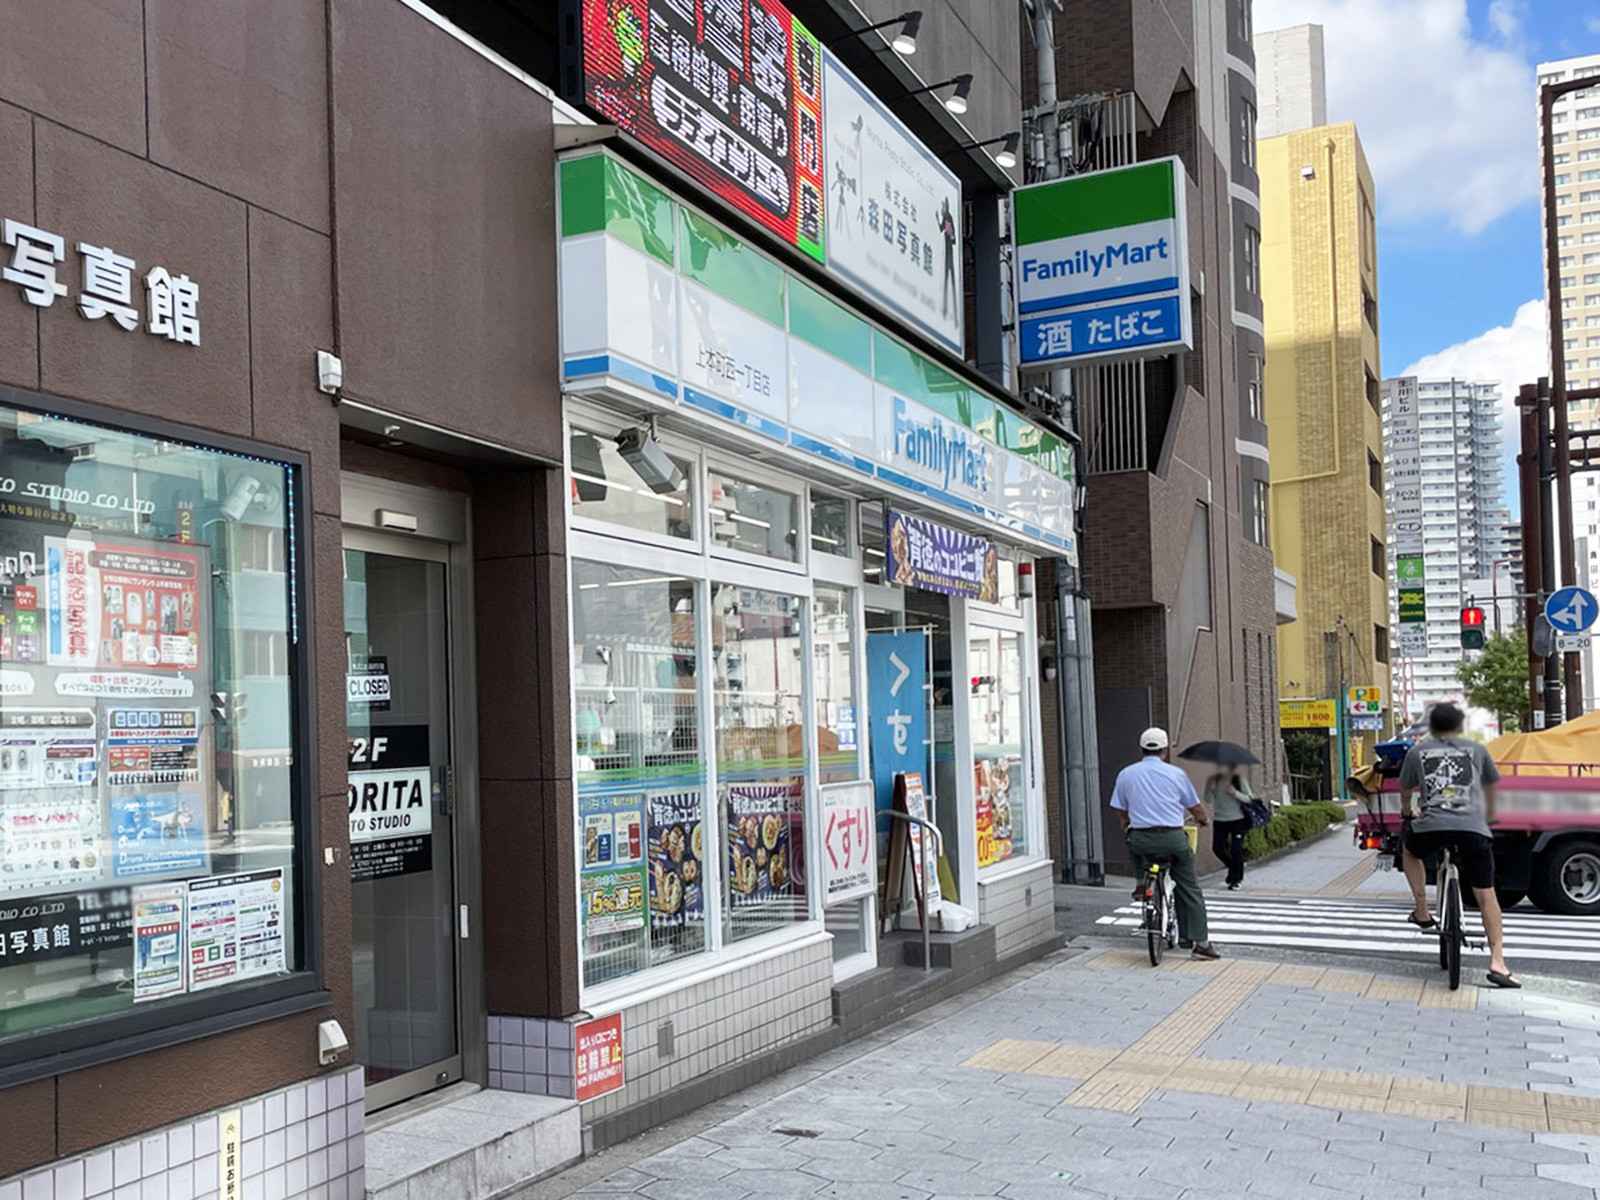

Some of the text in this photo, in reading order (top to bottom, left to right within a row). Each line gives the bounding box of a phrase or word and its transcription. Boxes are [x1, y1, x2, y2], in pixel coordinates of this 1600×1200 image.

[1, 218, 201, 347] 写真館
[1023, 237, 1168, 283] FamilyMart
[1037, 309, 1165, 356] 酒 たばこ
[695, 341, 771, 398] 上本町西一丁目店
[891, 397, 987, 490] FamilyMart
[20, 481, 90, 505] STUDIO
[91, 493, 119, 509] CO
[349, 678, 389, 696] CLOSED
[351, 737, 389, 763] 2F
[369, 814, 411, 831] STUDIO
[825, 806, 870, 871] くすり
[577, 1076, 588, 1088] NO
